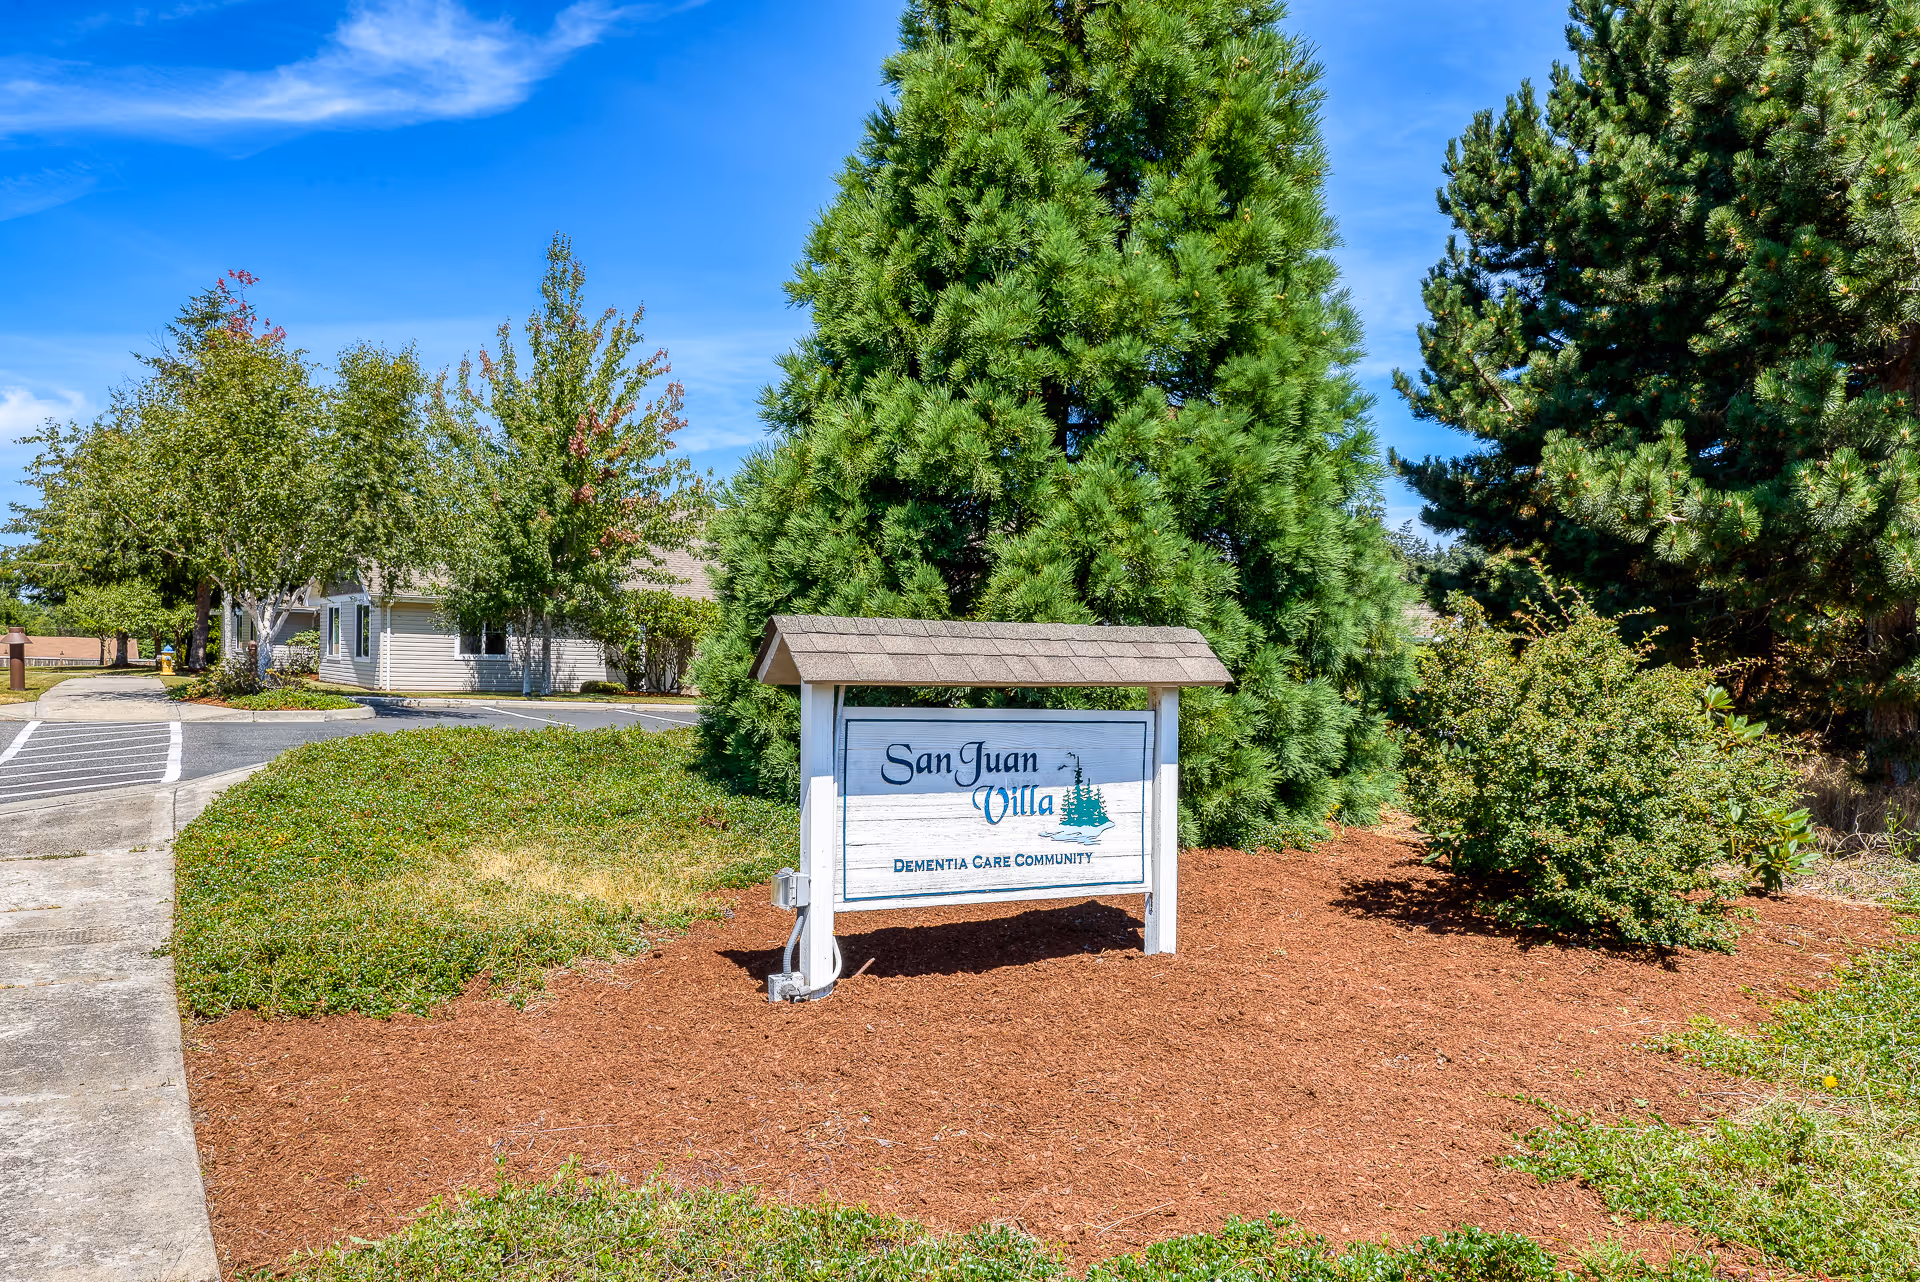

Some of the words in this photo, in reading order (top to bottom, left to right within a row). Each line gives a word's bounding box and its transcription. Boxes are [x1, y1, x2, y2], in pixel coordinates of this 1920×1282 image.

[881, 743, 952, 785] San
[954, 740, 1039, 787] Juan
[972, 784, 1054, 825] Villa
[893, 858, 968, 873] DEMENTIA
[972, 855, 1011, 869] CARE
[1014, 852, 1093, 867] COMMUNITY
